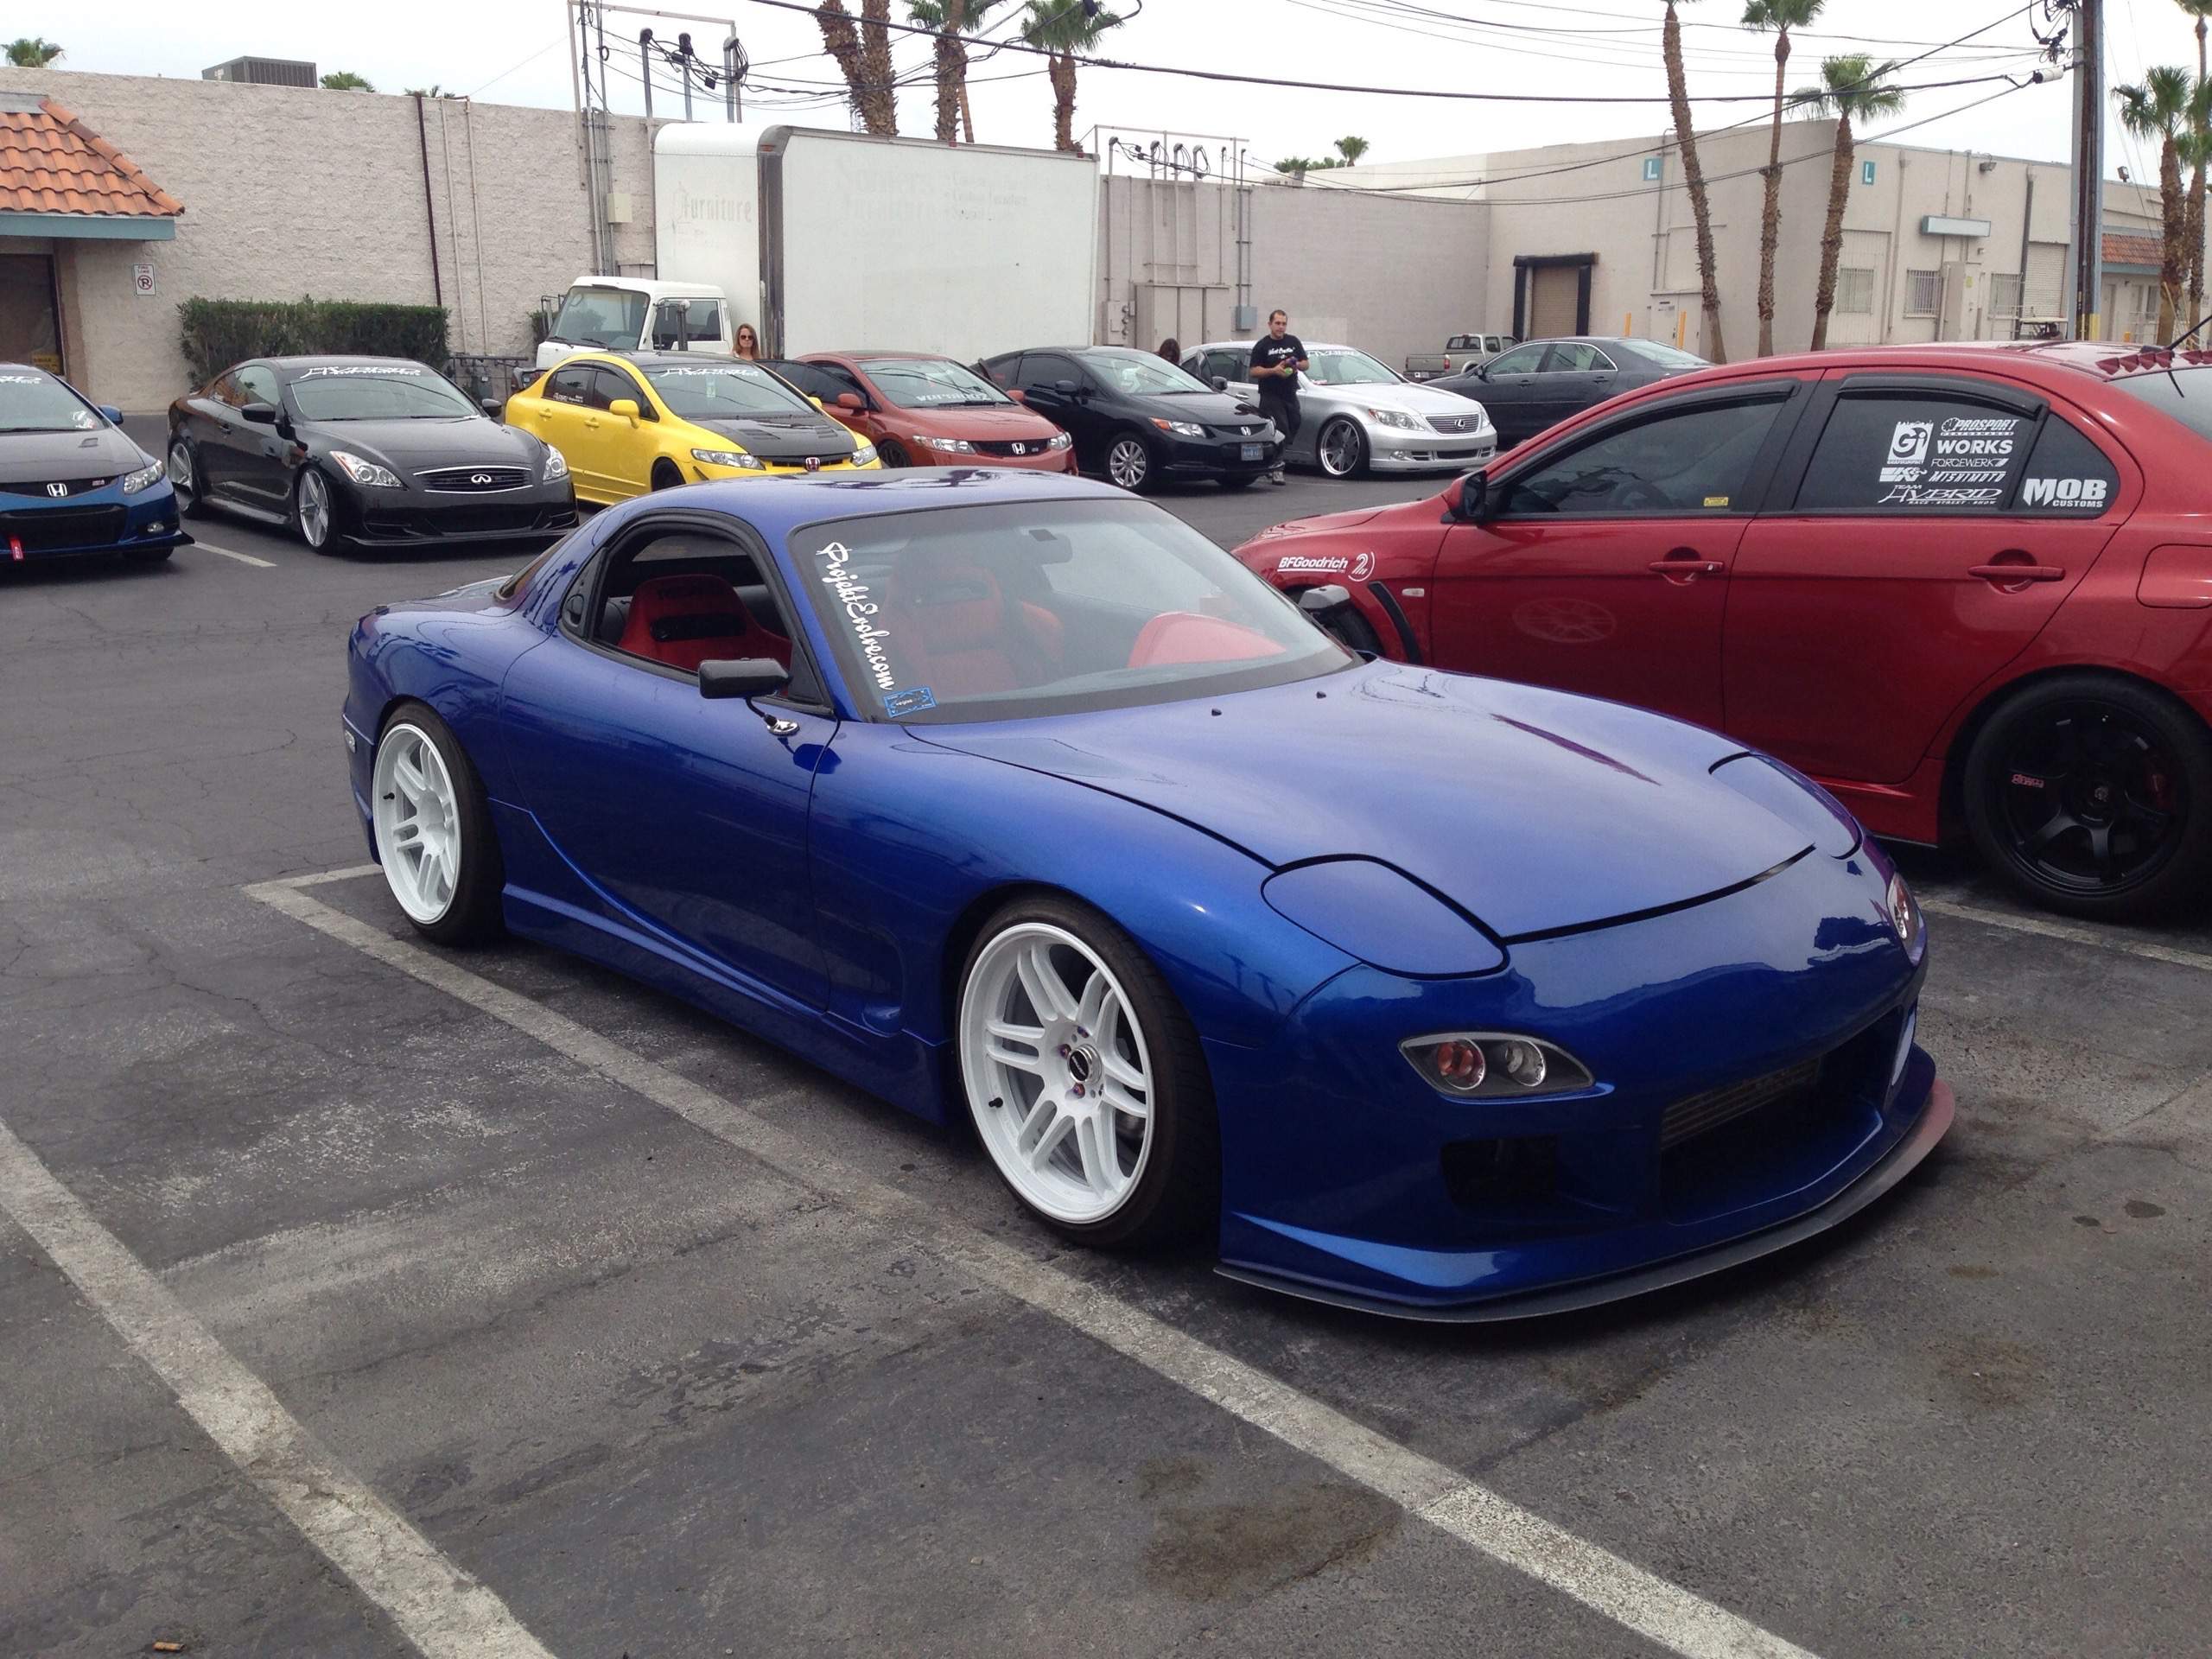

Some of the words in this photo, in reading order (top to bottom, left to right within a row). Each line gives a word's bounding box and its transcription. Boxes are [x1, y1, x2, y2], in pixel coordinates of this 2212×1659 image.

[1647, 160, 1657, 179] L
[1864, 163, 1872, 182] L
[1953, 418, 2020, 432] PROSPORT
[1936, 439, 2013, 454] WORKS
[1928, 470, 2006, 482] MISHIMOTO
[2023, 478, 2107, 506] MOB
[2051, 499, 2104, 508] CUSTOMS
[1277, 556, 1349, 569] BFGoodrich
